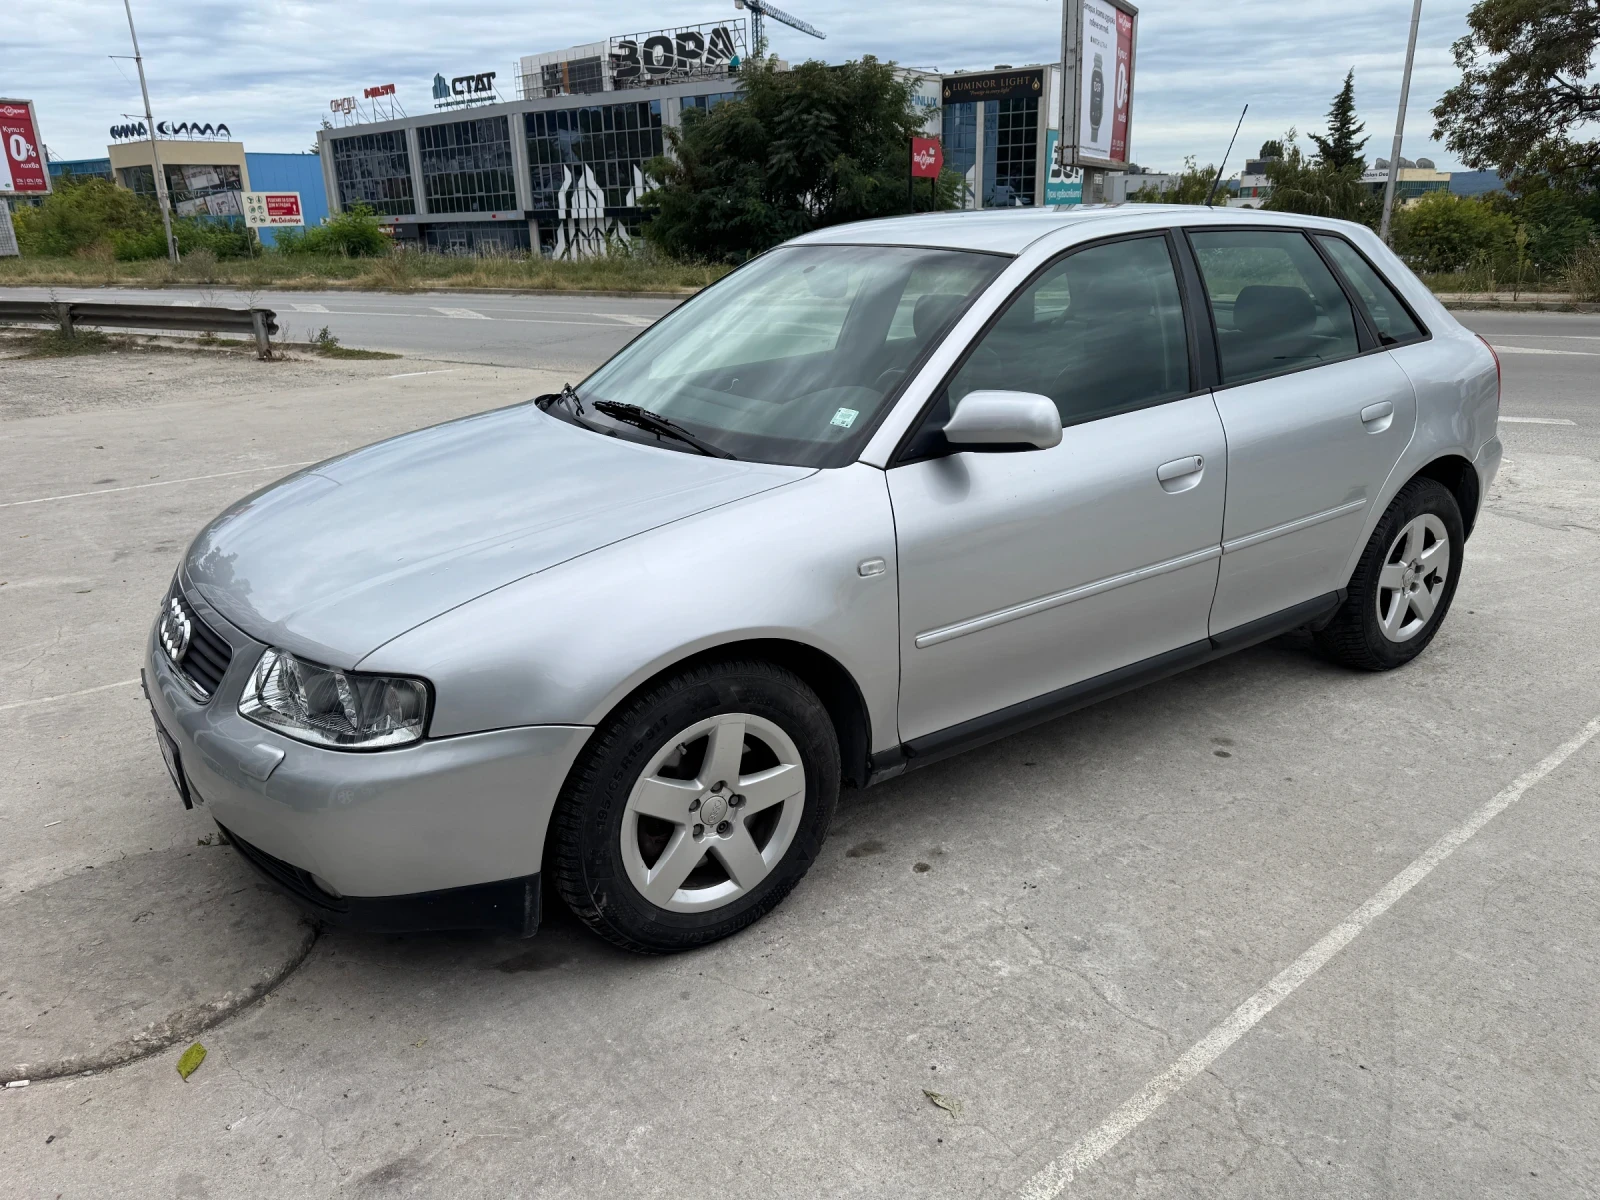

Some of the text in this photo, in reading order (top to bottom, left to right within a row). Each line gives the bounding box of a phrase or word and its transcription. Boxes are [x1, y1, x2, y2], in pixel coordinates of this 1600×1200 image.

[616, 27, 739, 79] ЗОРА
[452, 71, 496, 95] СТАТ
[953, 76, 1030, 91] LUMINOR LIGHT
[2, 126, 20, 134] Купи
[9, 134, 37, 161] 0%
[596, 769, 624, 828] 195/65
[620, 740, 645, 770] R15
